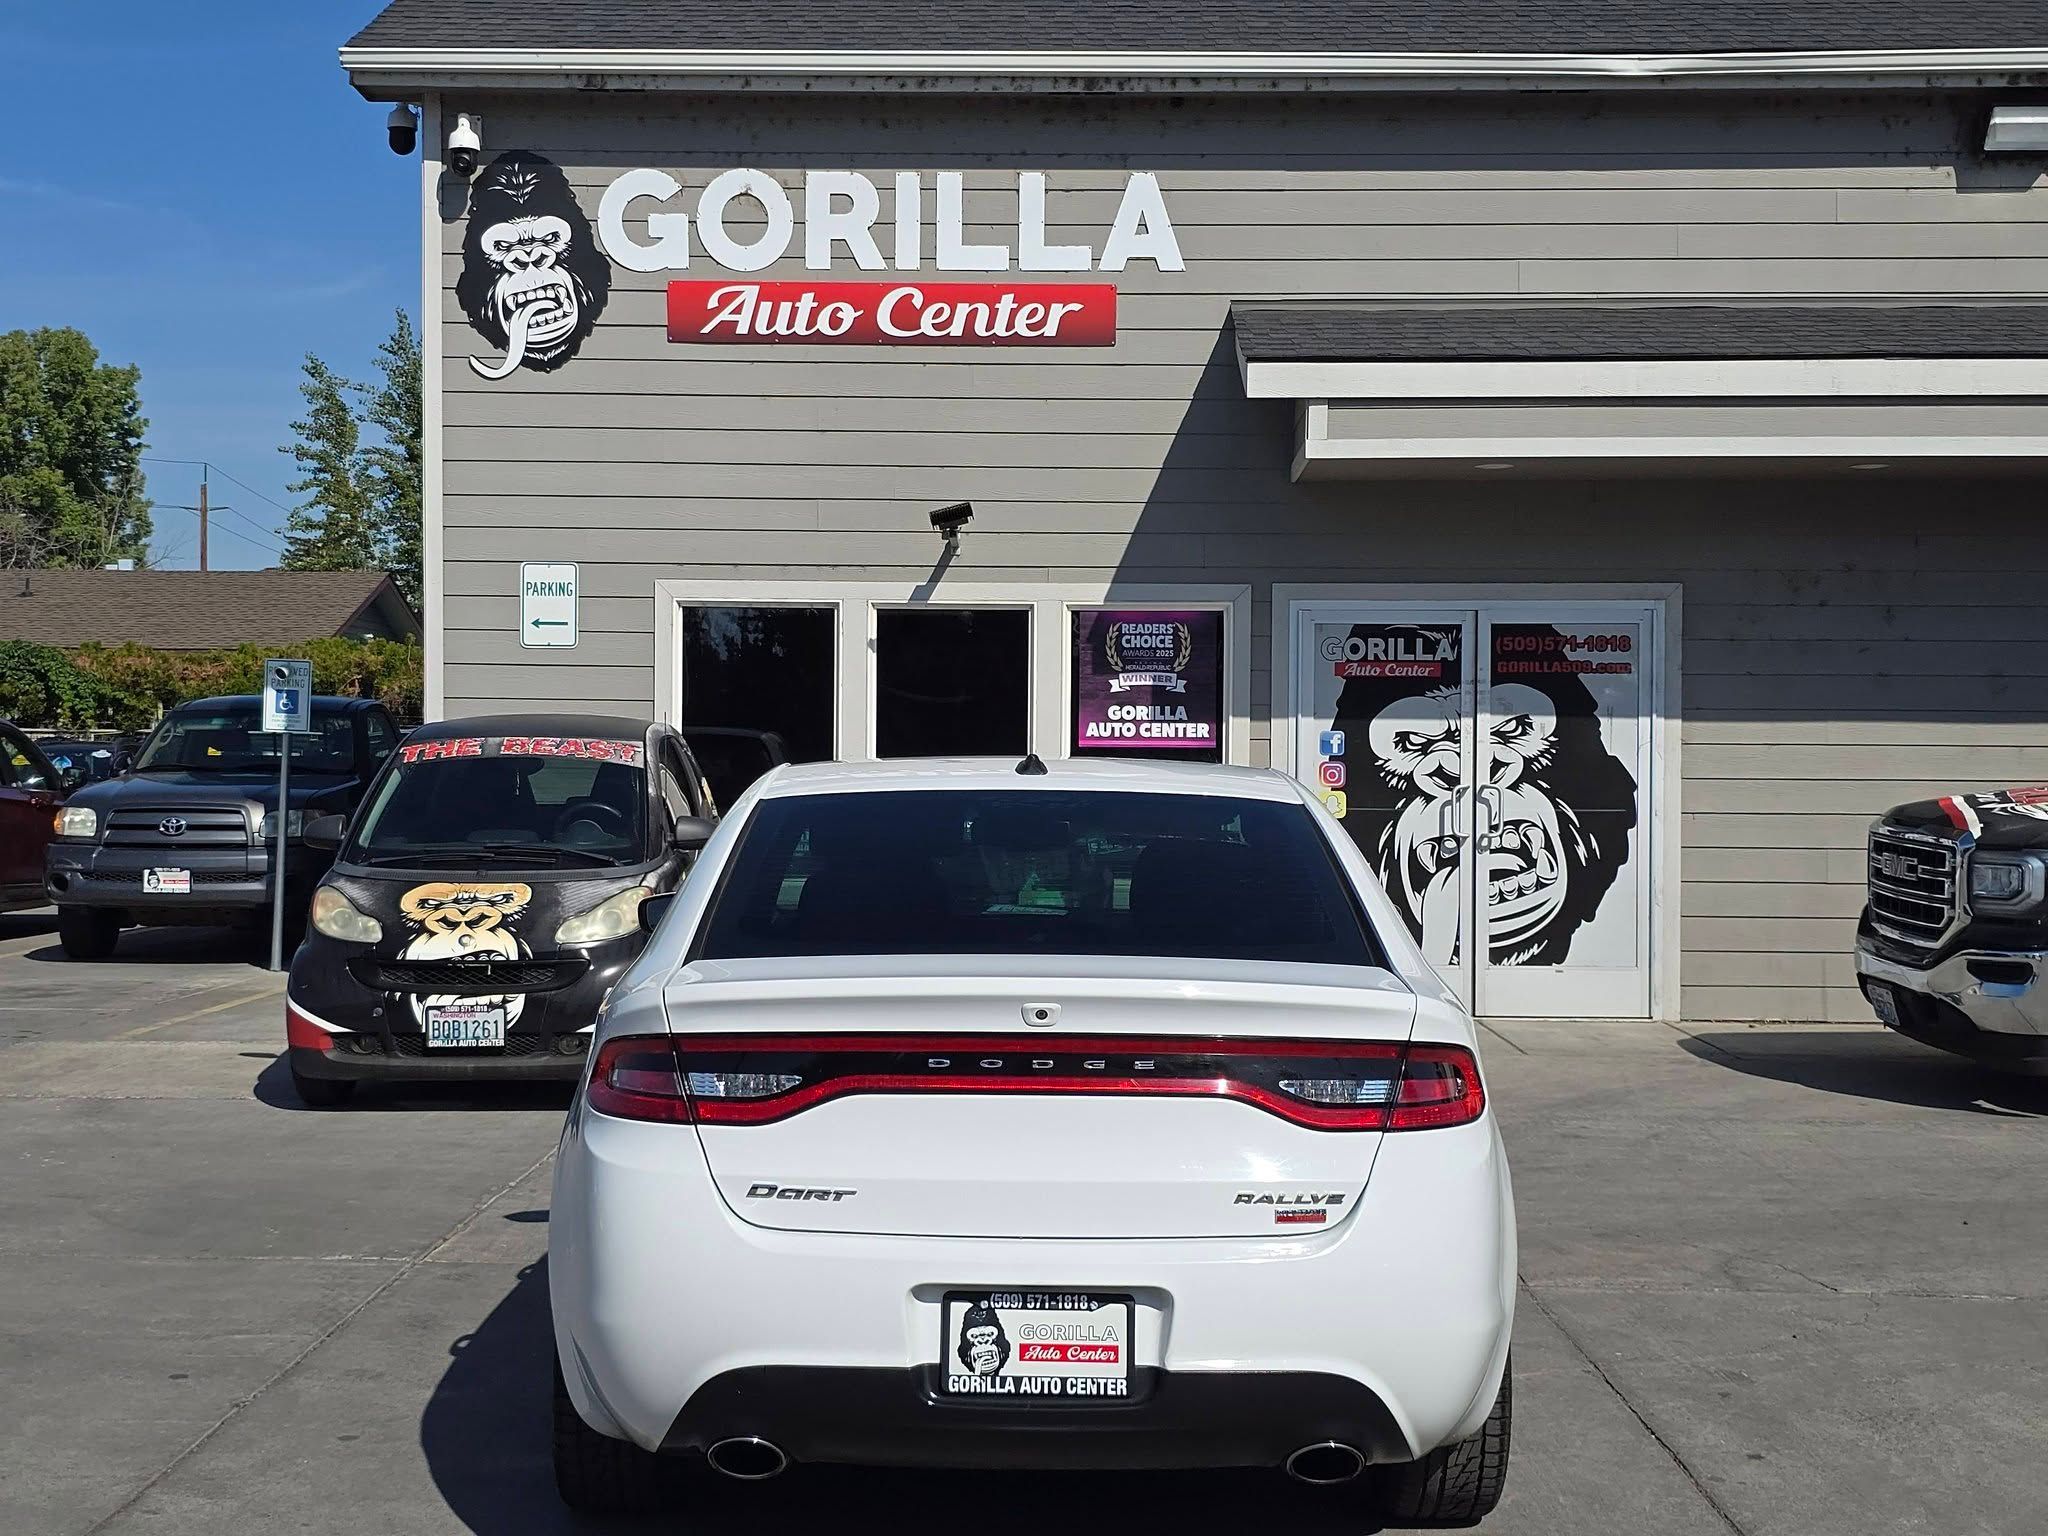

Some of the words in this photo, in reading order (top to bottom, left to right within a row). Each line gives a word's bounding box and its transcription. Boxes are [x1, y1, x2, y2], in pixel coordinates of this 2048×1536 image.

[597, 168, 1186, 273] GORILLA
[700, 285, 864, 336] Auto
[876, 286, 1084, 338] Center
[526, 582, 573, 597] PARKING
[1121, 635, 1174, 648] CHOICE
[1320, 636, 1455, 661] GORILLA
[1495, 634, 1632, 654] (509)571-1818
[1122, 649, 1155, 657] AWARDS
[1155, 649, 1174, 657] 2025
[269, 666, 309, 677] RVED
[1343, 662, 1382, 677] Auto
[1384, 663, 1434, 677] Center
[1497, 660, 1632, 674] GORILLA509.com
[271, 678, 305, 688] PARKING
[1121, 675, 1173, 683] WINNER
[1107, 705, 1188, 720] GORILLA
[1085, 722, 1137, 738] AUTO
[1139, 722, 1210, 738] CENTER
[400, 737, 486, 764] THE
[500, 737, 643, 765] BEAST
[1882, 852, 1919, 881] GMC
[432, 1020, 499, 1039] BQB1261
[459, 1039, 477, 1047] AUTO
[928, 1058, 1155, 1070] DODGE
[1233, 1193, 1346, 1205] RALLYE
[990, 1293, 1023, 1309] (509)
[1027, 1294, 1088, 1310] 571-1818
[1018, 1323, 1119, 1342] GORILLA
[1023, 1344, 1062, 1360] Auto
[1067, 1346, 1117, 1362] Center
[948, 1374, 1016, 1394] GORILLA
[1019, 1376, 1063, 1395] AUTO
[1066, 1377, 1128, 1396] CENTER
